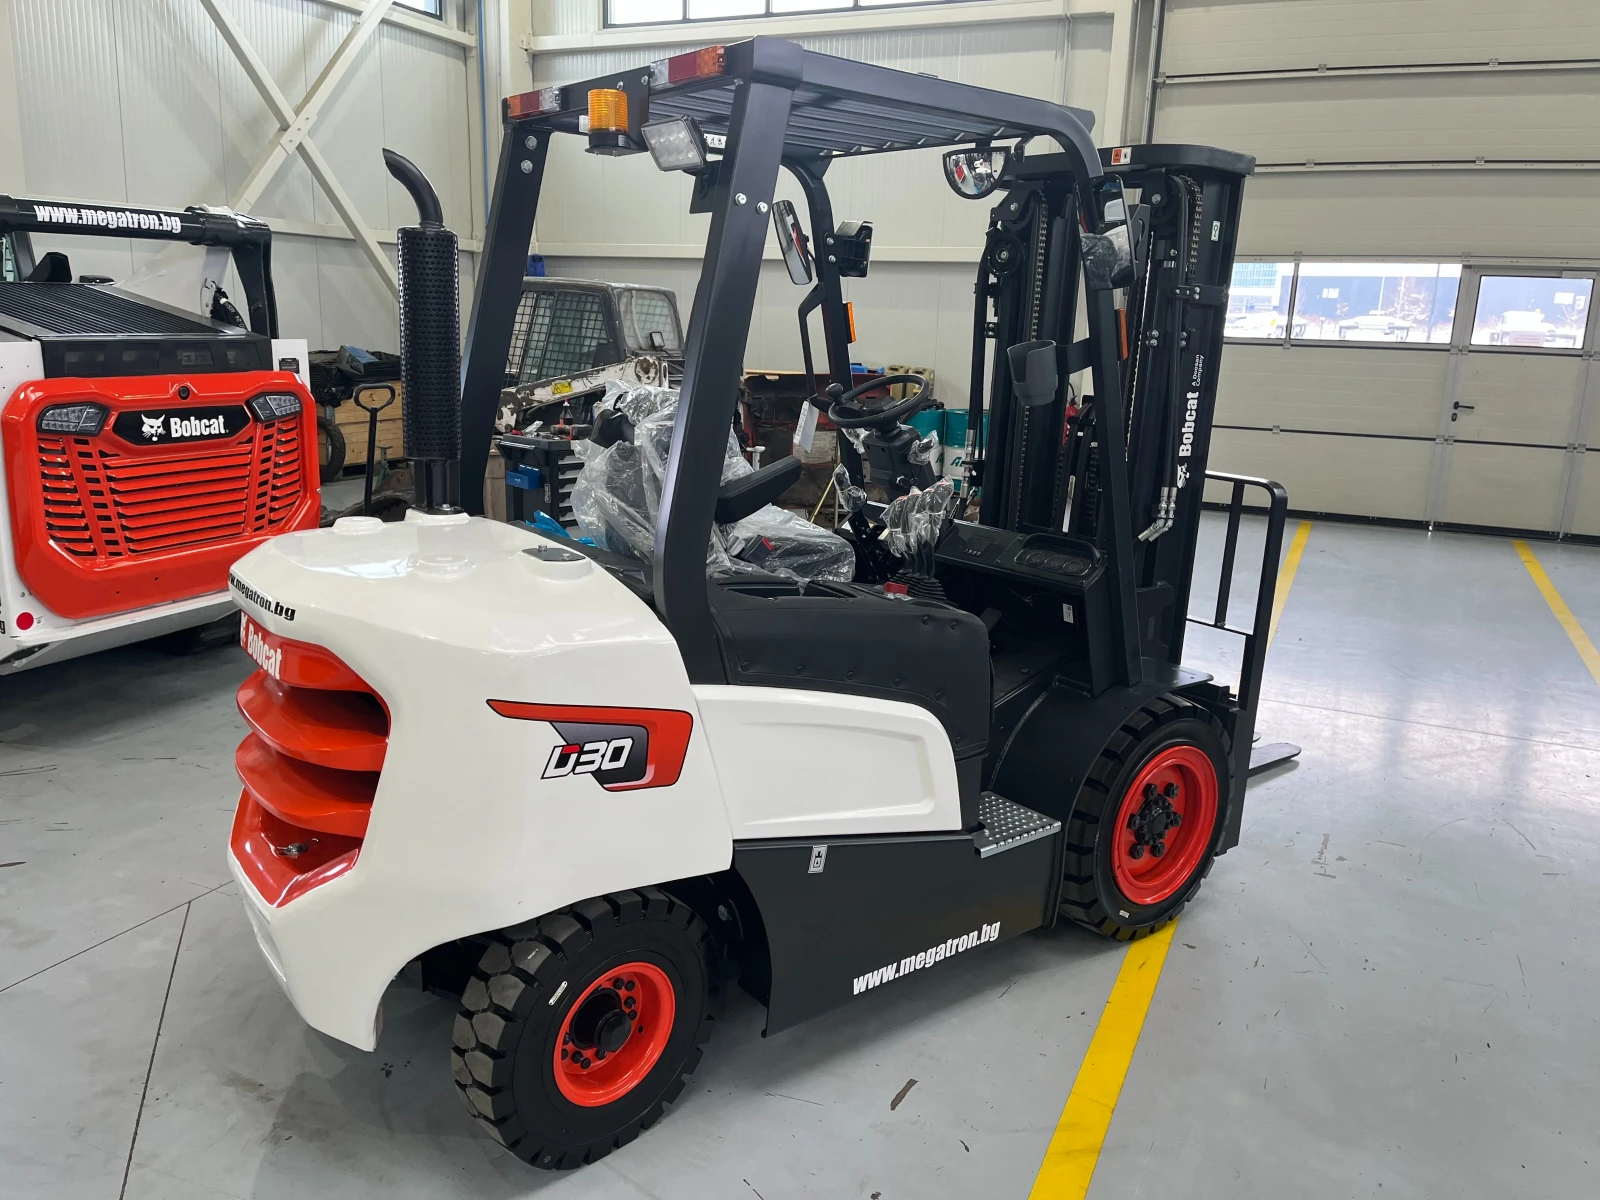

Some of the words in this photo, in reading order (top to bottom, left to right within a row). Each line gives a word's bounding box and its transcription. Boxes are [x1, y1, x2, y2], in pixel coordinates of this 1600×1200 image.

[33, 205, 182, 233] www.megatron.bg
[1196, 355, 1205, 387] Company
[169, 415, 226, 438] Bobcat
[1178, 391, 1199, 457] Bobcat
[247, 622, 282, 680] Bobcat
[540, 737, 634, 779] D30
[853, 921, 1001, 996] www.megatron.bg
